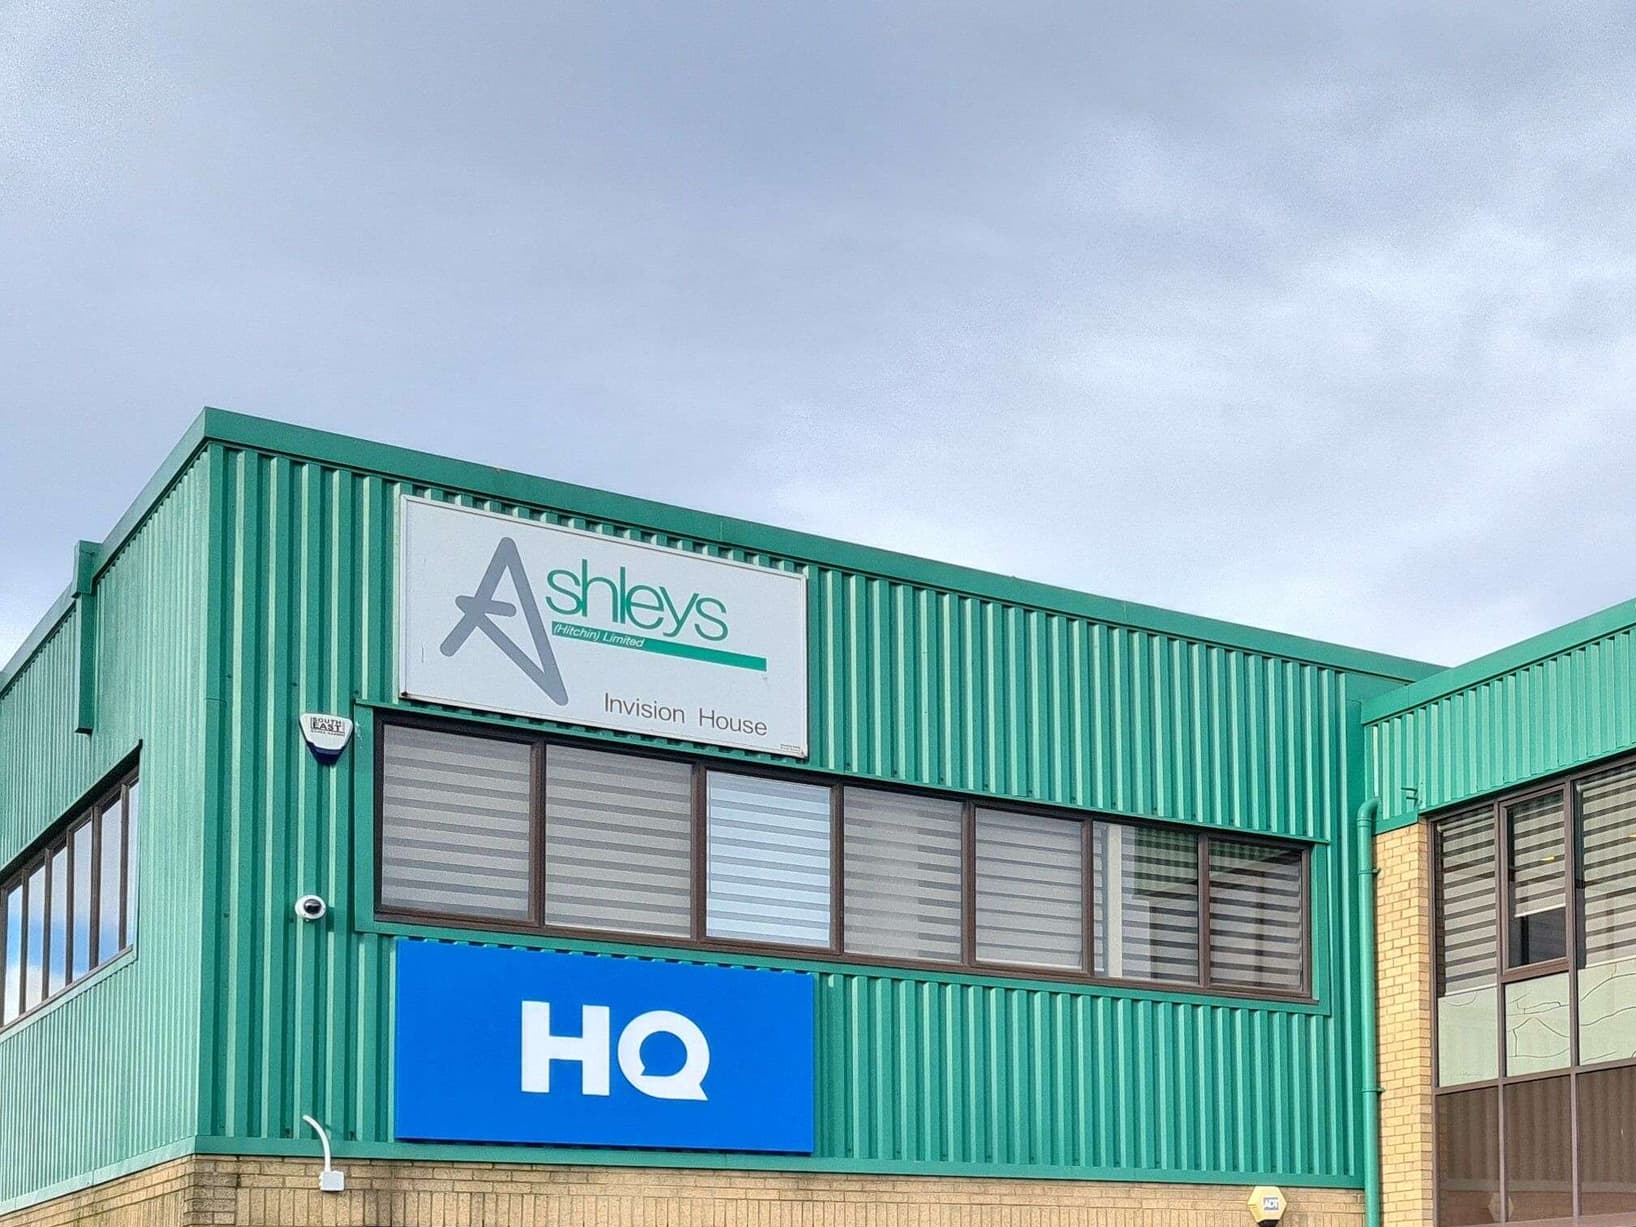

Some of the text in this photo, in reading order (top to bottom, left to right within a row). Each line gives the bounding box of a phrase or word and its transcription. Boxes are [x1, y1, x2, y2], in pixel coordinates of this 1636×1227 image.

[440, 536, 729, 706] Ashleys
[553, 623, 645, 647] (Hitchin) Limited
[313, 717, 341, 725] SOUTH
[313, 721, 341, 732] EAST
[605, 693, 768, 736] Invision House
[521, 1000, 710, 1101] HQ
